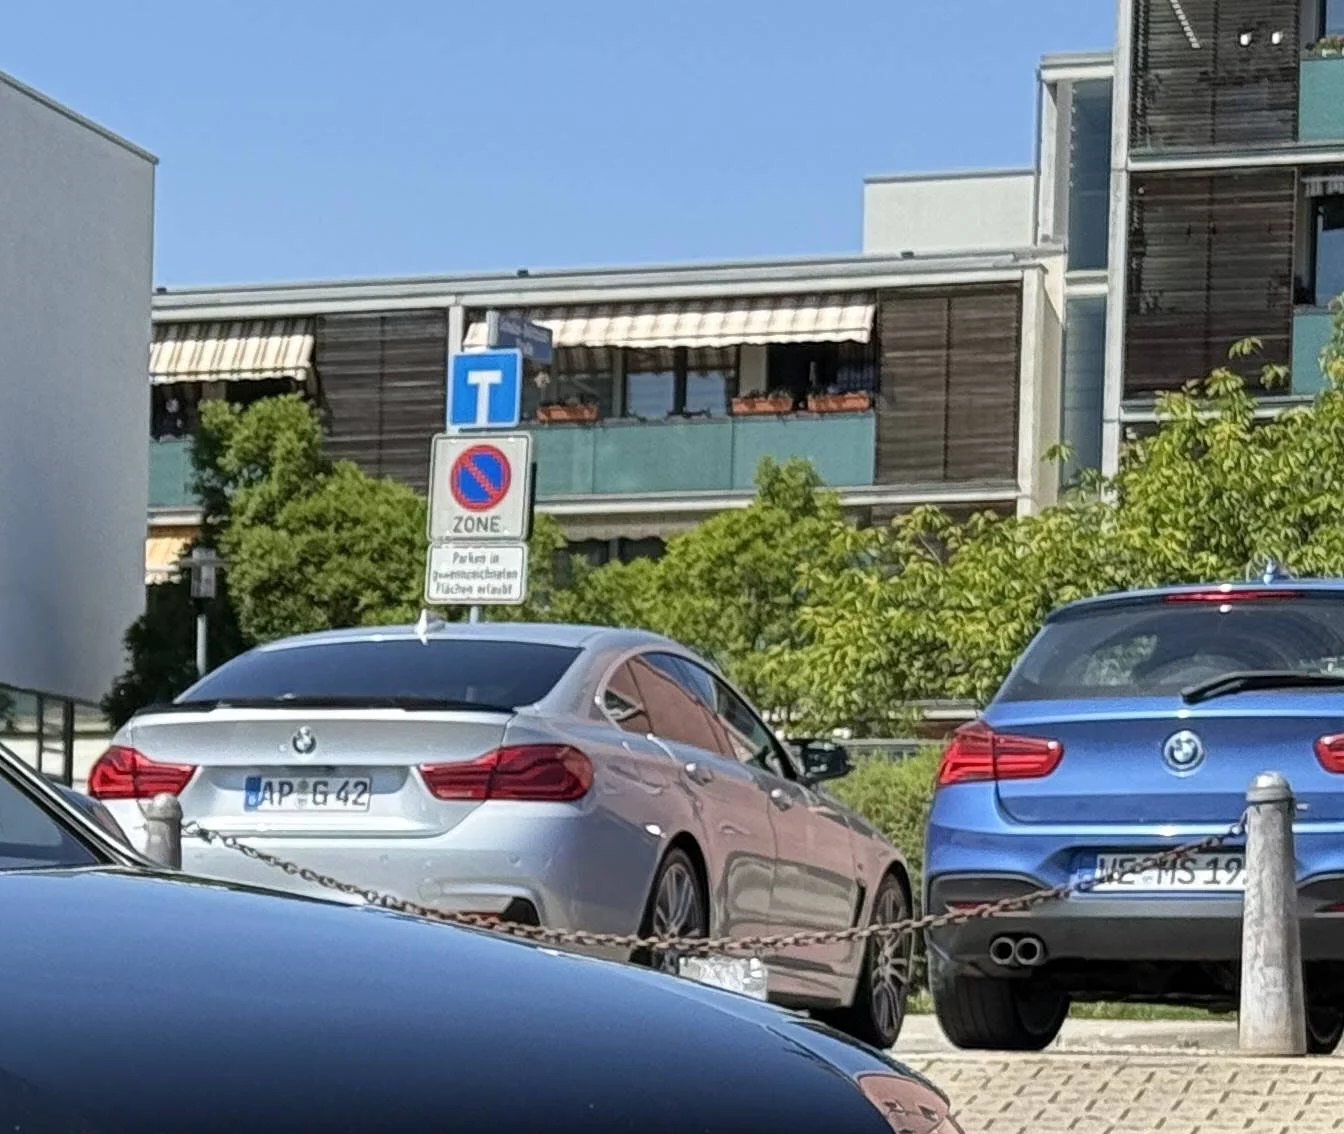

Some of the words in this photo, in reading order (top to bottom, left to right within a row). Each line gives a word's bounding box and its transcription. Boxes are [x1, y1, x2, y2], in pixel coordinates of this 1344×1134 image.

[452, 515, 501, 533] ZONE
[452, 551, 486, 564] Parken
[261, 781, 294, 806] AP
[312, 780, 329, 806] G
[335, 780, 368, 806] 42
